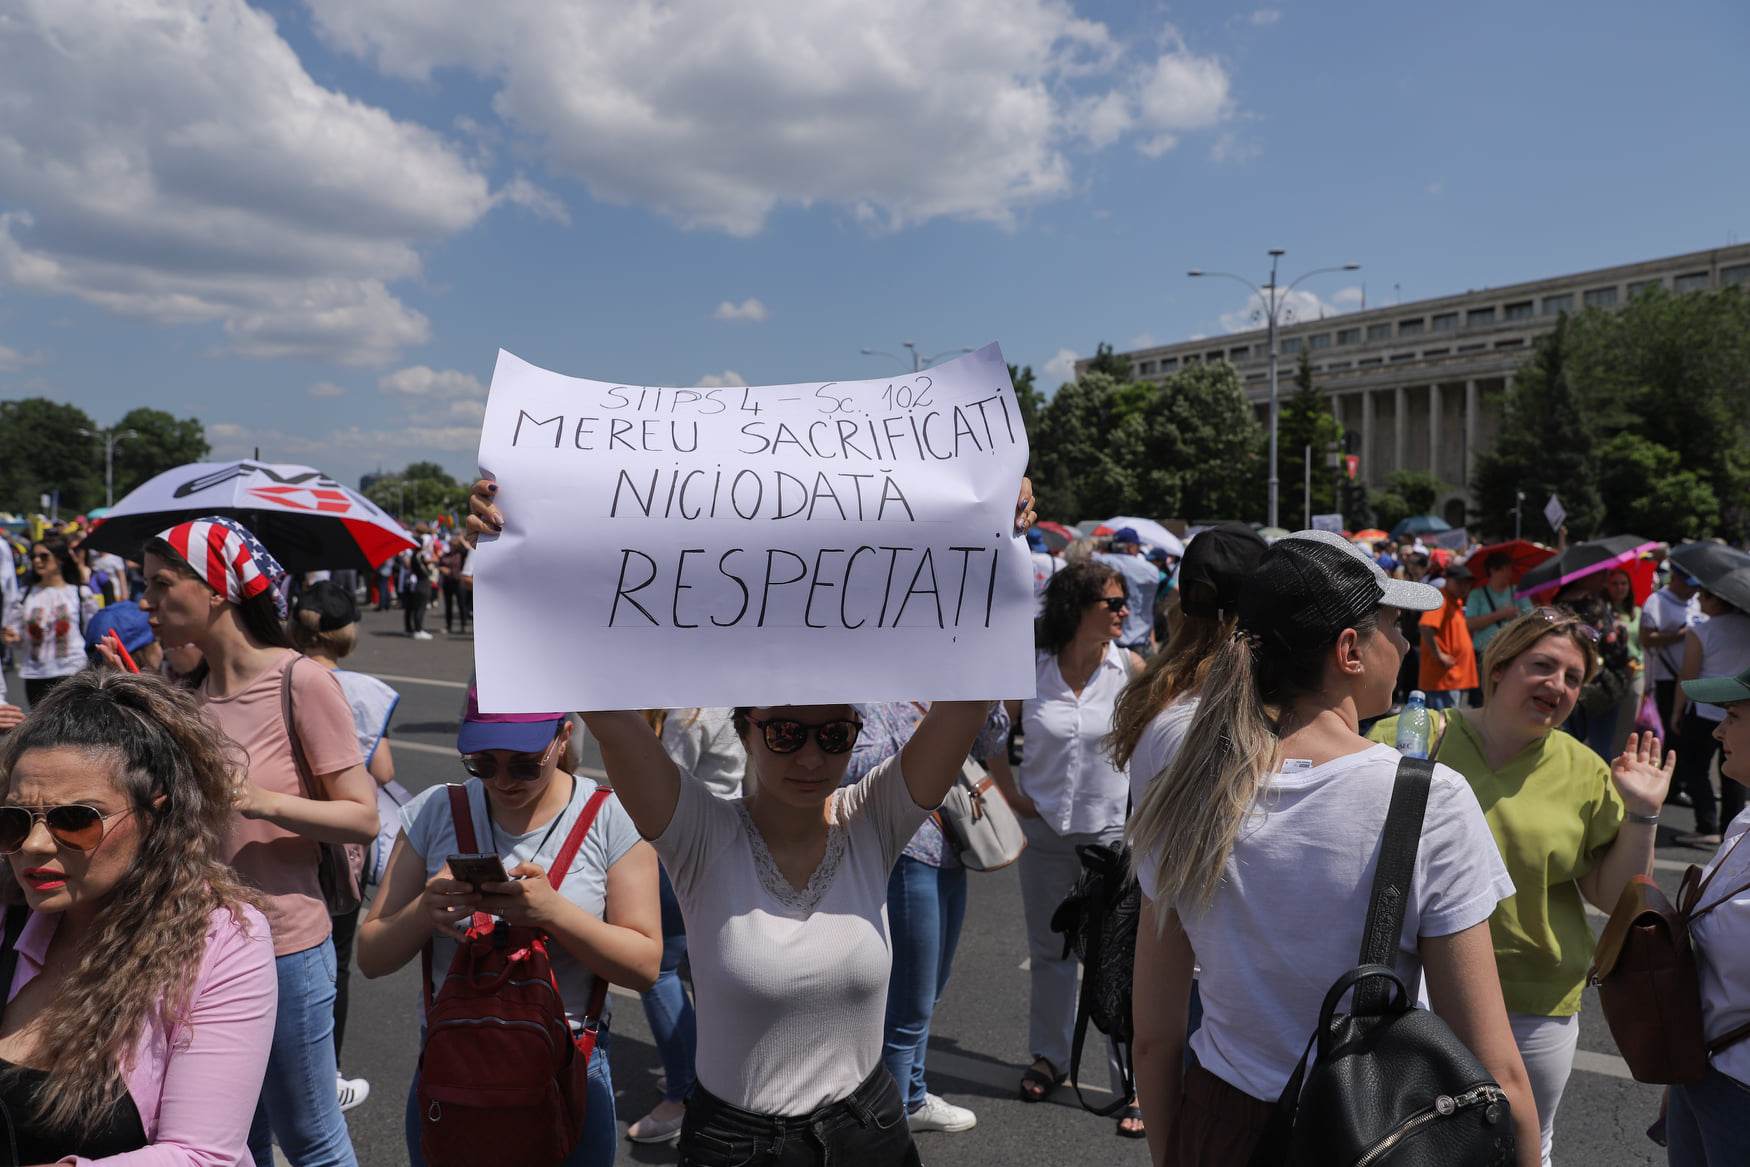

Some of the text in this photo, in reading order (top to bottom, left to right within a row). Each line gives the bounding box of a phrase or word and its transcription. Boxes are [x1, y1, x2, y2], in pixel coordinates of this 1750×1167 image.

[882, 376, 934, 411] 102
[512, 408, 699, 453] MEREU
[609, 462, 917, 521] NICIODATĂ
[608, 532, 1002, 643] RESPECTAȚI
